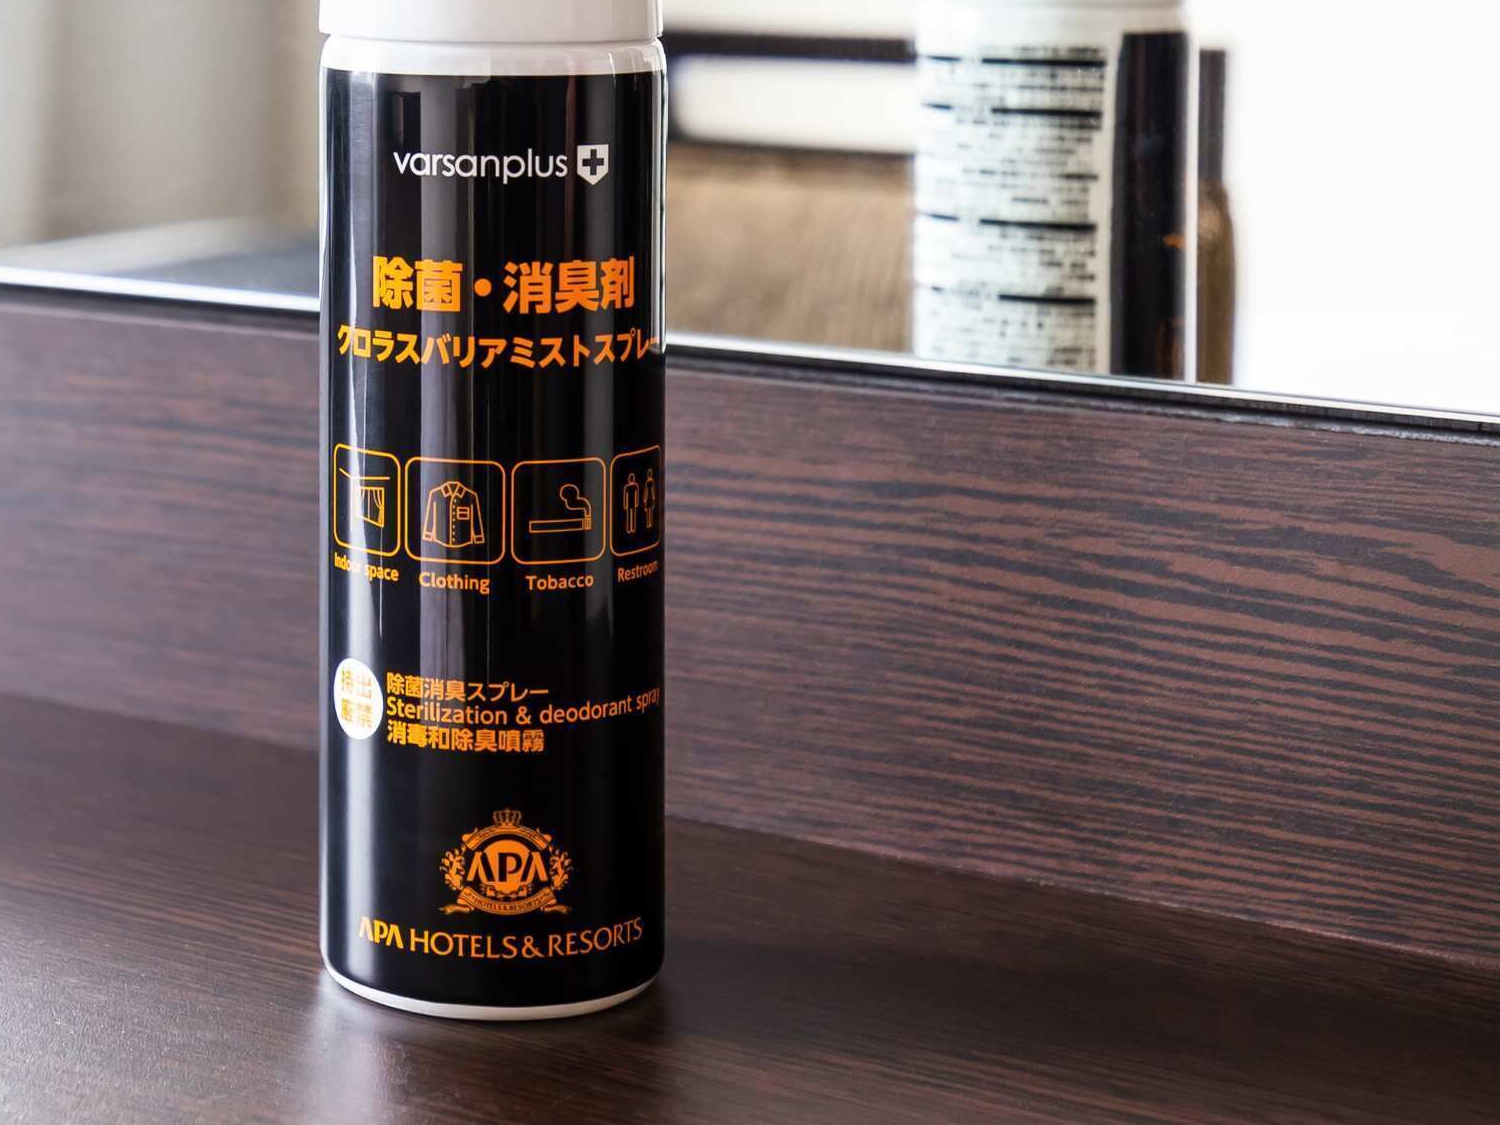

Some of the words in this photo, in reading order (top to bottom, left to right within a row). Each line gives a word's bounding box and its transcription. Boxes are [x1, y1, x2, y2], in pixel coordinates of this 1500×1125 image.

[393, 148, 568, 184] varsanplus
[372, 253, 635, 314] 除菌・消臭剤
[364, 563, 399, 582] space
[418, 572, 490, 594] Clothing
[525, 574, 594, 591] Tobacco
[386, 672, 549, 703] 除菌消臭スプレー
[386, 696, 508, 725] Sterilization
[515, 706, 532, 725] &
[539, 695, 632, 725] deodorant
[387, 719, 545, 753] 消毒和除臭噴霧
[358, 915, 404, 950] APA
